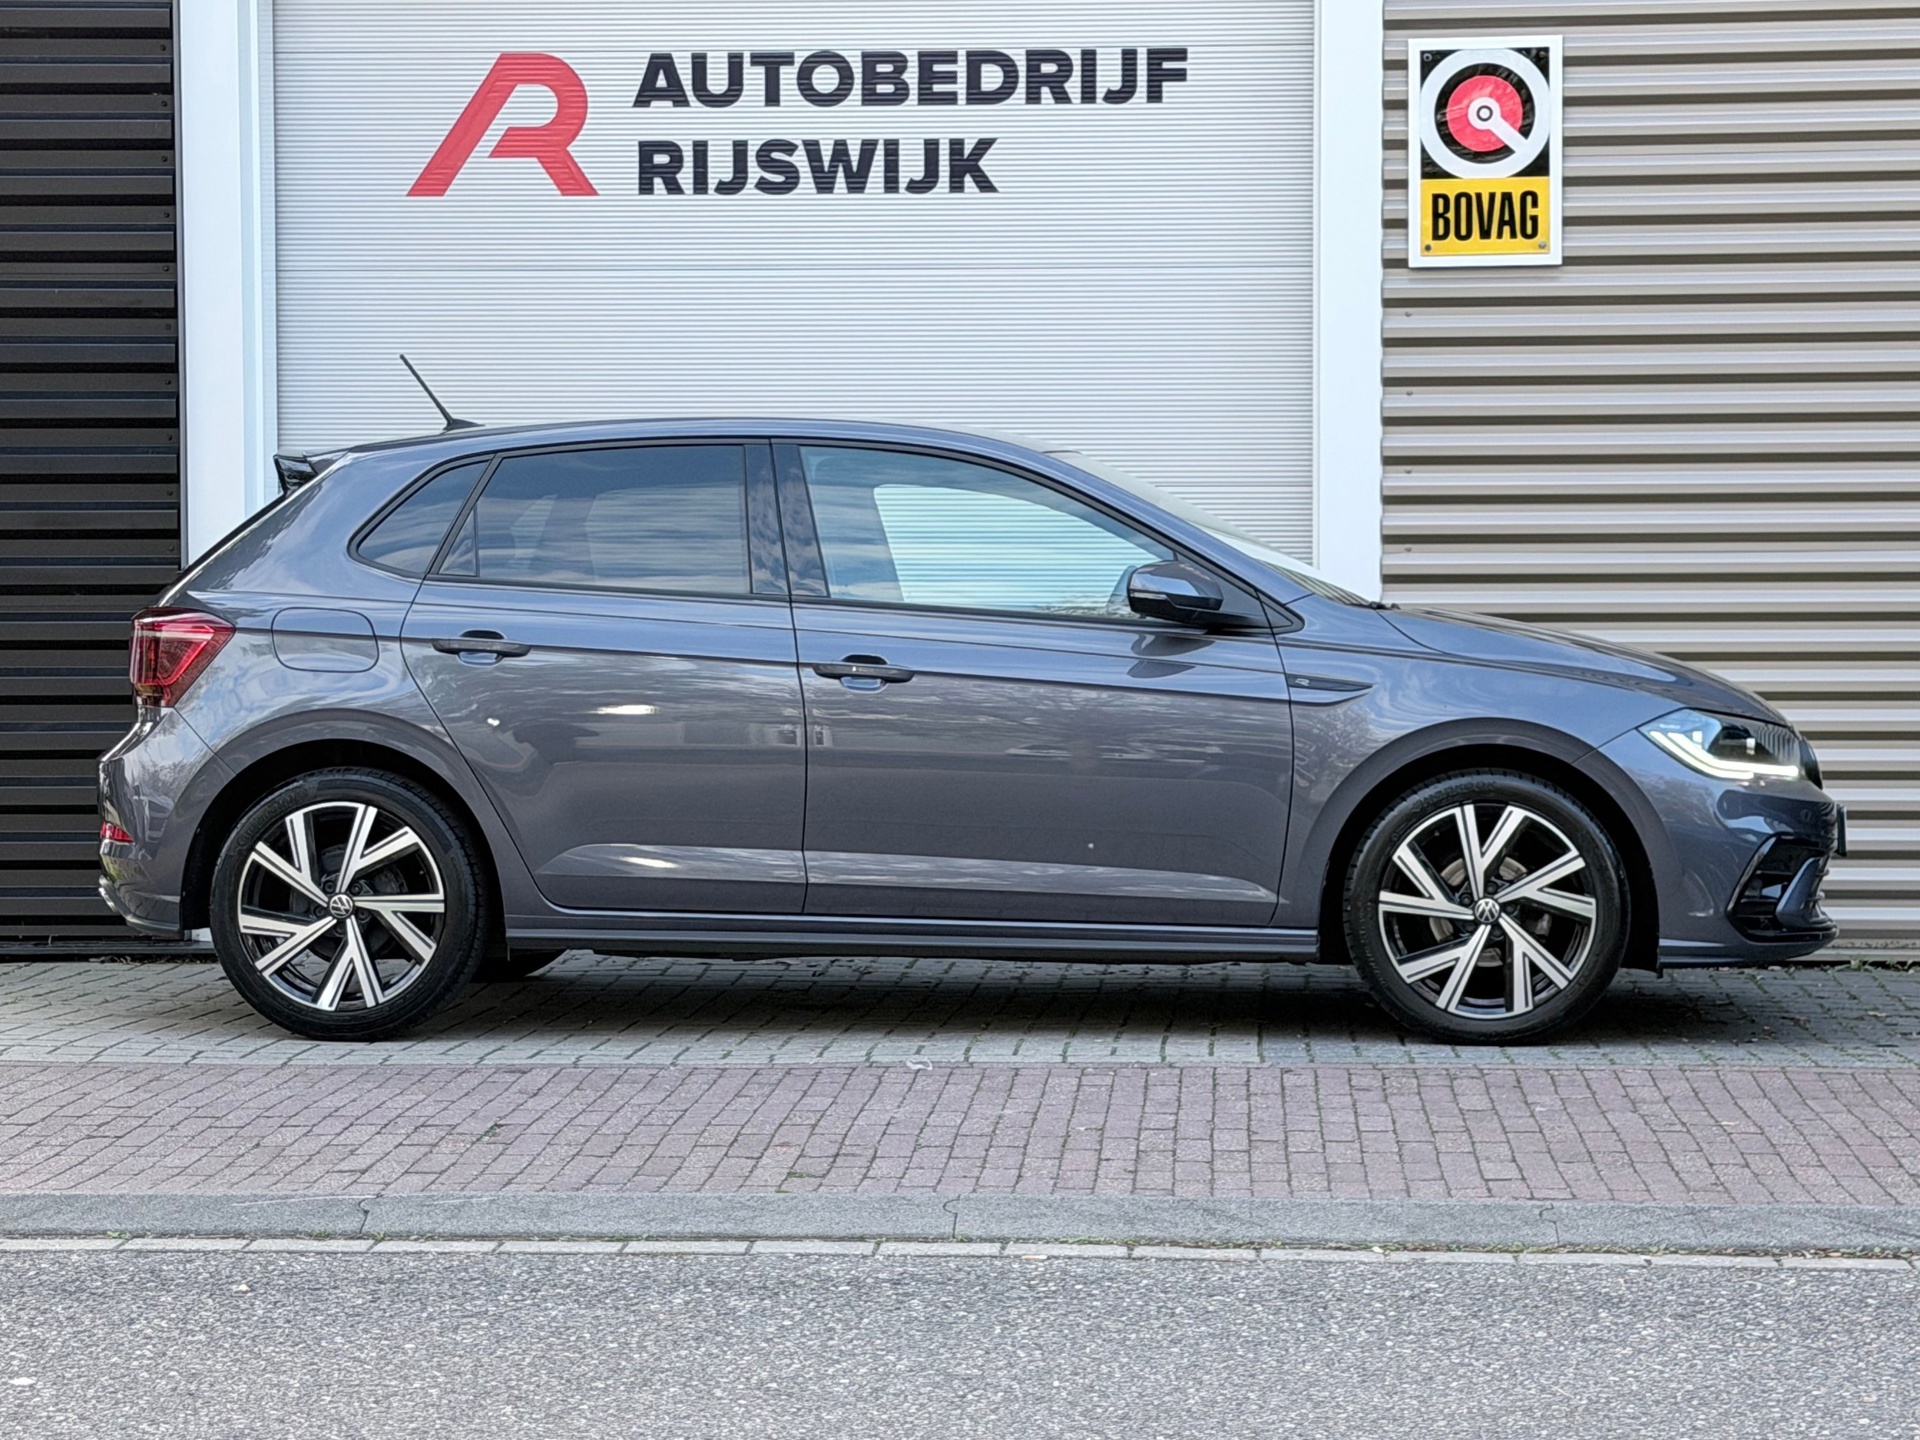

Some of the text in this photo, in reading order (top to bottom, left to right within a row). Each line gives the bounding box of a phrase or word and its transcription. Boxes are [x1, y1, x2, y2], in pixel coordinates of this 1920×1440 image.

[633, 48, 1188, 108] AUTOBEDRIJF
[638, 138, 998, 195] RIJSWIJK
[1431, 190, 1539, 241] BOVAG
